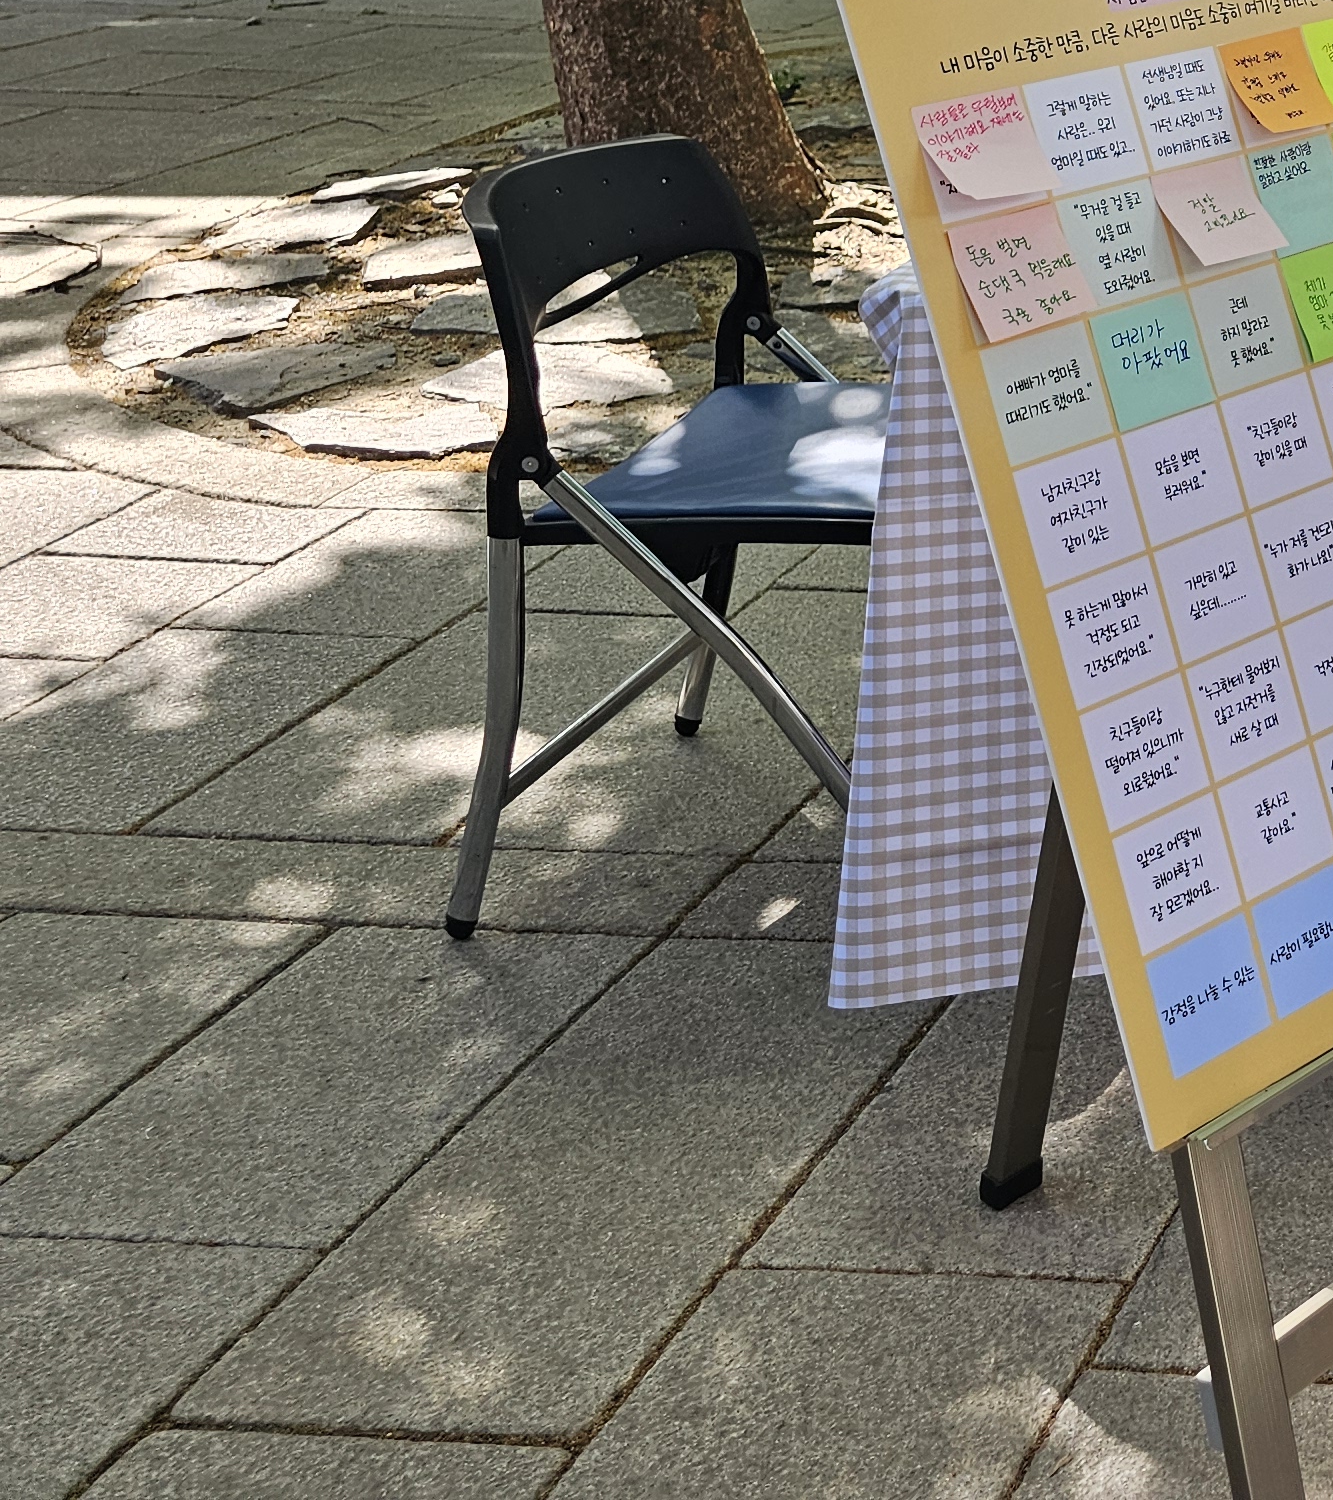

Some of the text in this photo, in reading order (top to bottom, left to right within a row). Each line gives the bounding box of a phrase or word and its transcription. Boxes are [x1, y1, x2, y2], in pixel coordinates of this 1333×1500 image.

[938, 55, 961, 74] 내
[962, 45, 1010, 72] 마음이
[1012, 35, 1055, 63] 소중한
[1054, 28, 1090, 55] 만큼,
[1090, 21, 1121, 47] 다른
[1122, 14, 1169, 40] 사람의
[1168, 7, 1207, 32] 마음도
[1207, 0, 1243, 25] 소중히
[1045, 90, 1112, 118] 그렇게 말하는
[1096, 115, 1117, 134] 우리
[1049, 148, 1085, 172] 엄마일
[1084, 144, 1110, 162] 때도
[1108, 193, 1124, 213] 걸
[1122, 190, 1143, 209] 들고
[1094, 220, 1133, 244] 있을 때
[1097, 243, 1147, 271] 옆 사람이
[1039, 467, 1102, 504] 남자친구랑
[1049, 494, 1108, 527] 여자친구가
[1060, 523, 1110, 555] 같이 있는
[1287, 527, 1309, 549] 저를
[1286, 557, 1311, 579] 화가
[1063, 581, 1149, 630] 못 하는게 많아서
[1085, 613, 1142, 646] 걱정도 되고
[1108, 706, 1164, 743] 친구들이랑
[1103, 727, 1185, 775] 떨어져 있으니까
[1160, 964, 1255, 1026] 감정을 나눌 수 있는
